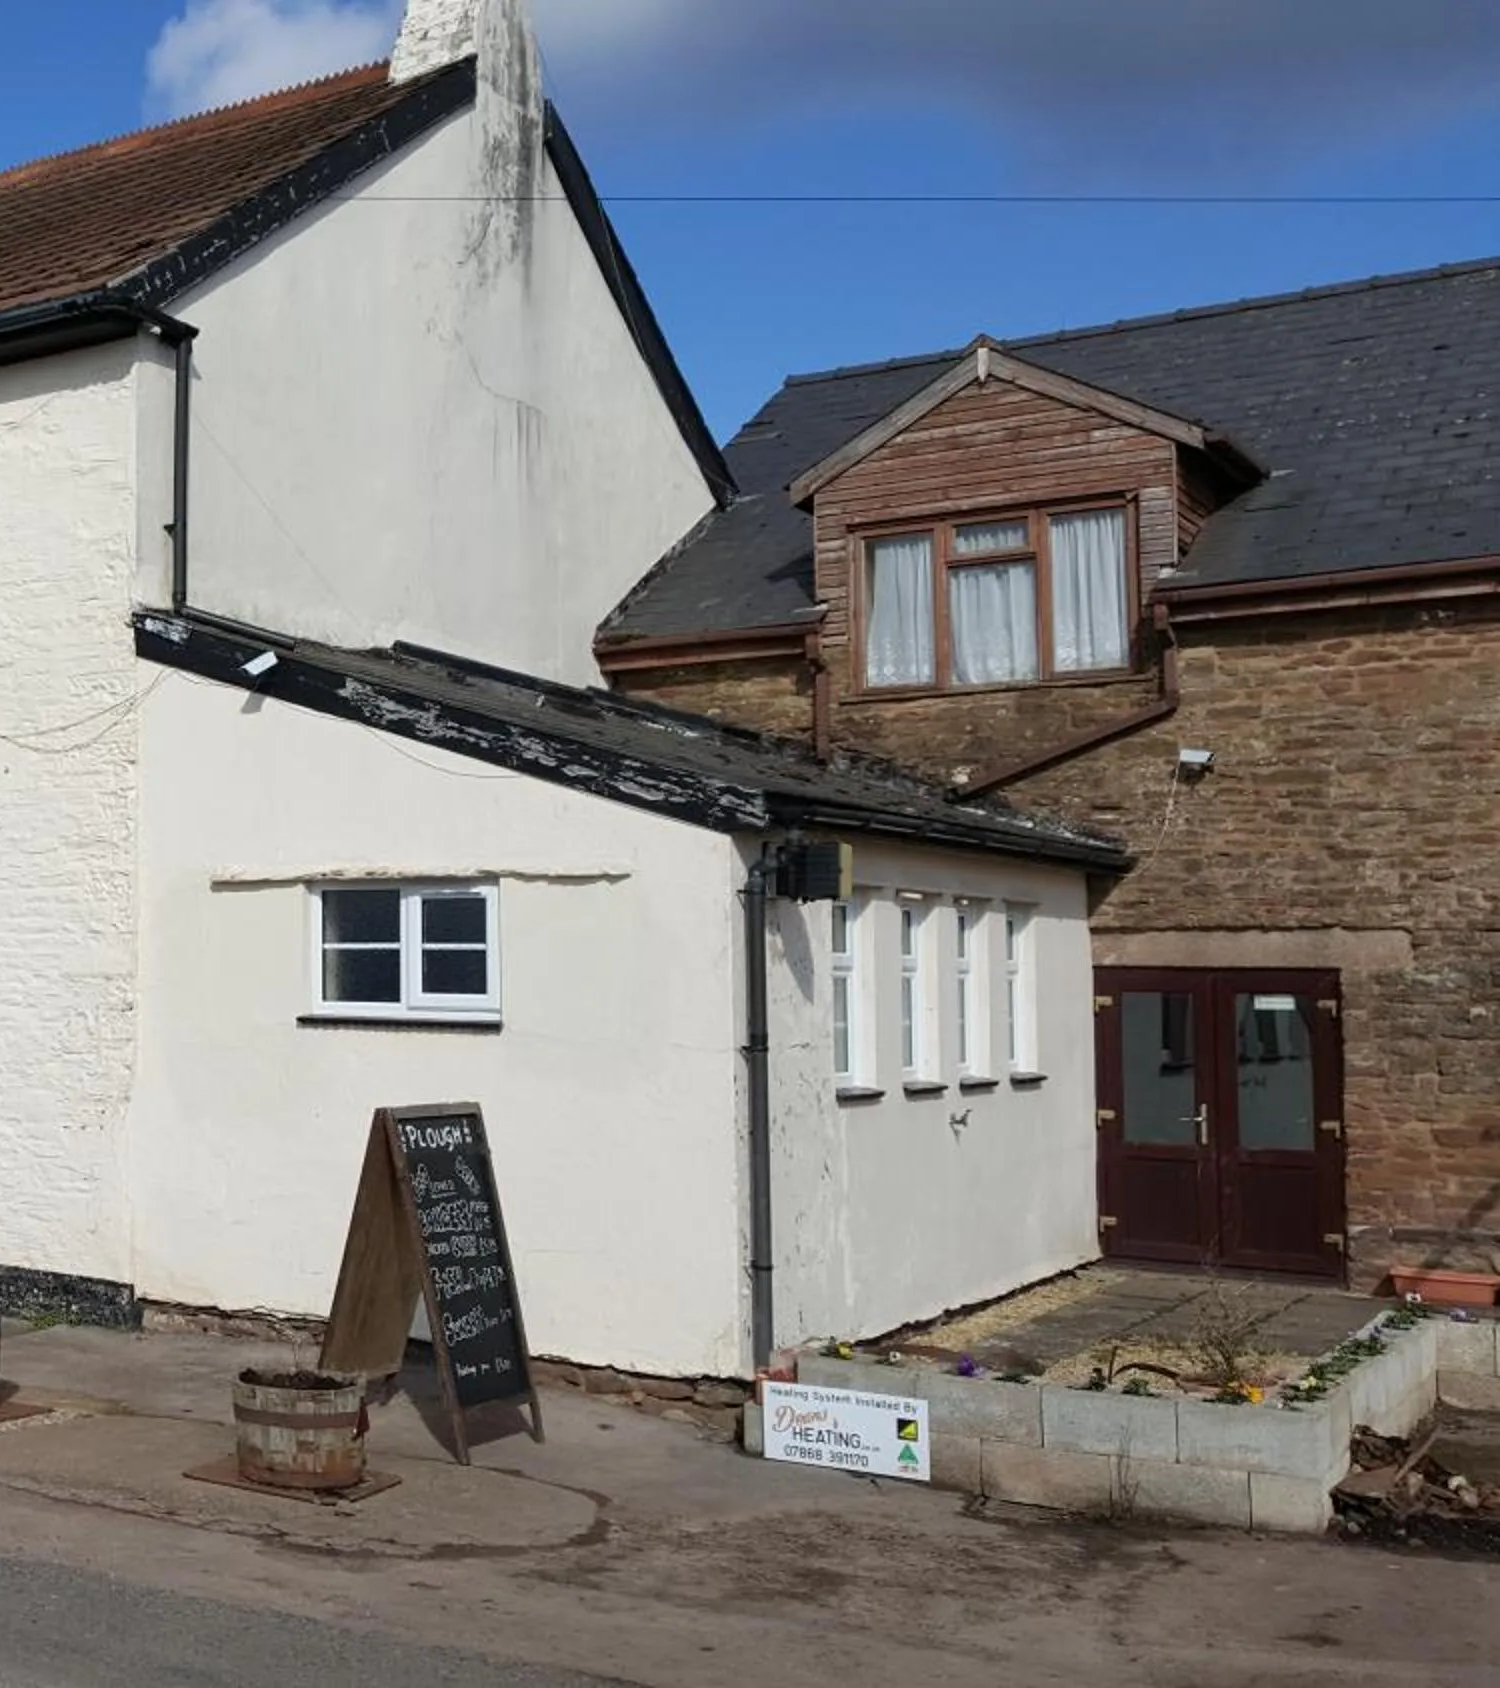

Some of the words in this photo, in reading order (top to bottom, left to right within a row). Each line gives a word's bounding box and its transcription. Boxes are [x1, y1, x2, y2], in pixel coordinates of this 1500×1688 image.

[769, 1386, 809, 1401] Heating
[812, 1391, 852, 1405] System
[903, 1401, 917, 1415] By
[792, 1427, 862, 1450] HEATING
